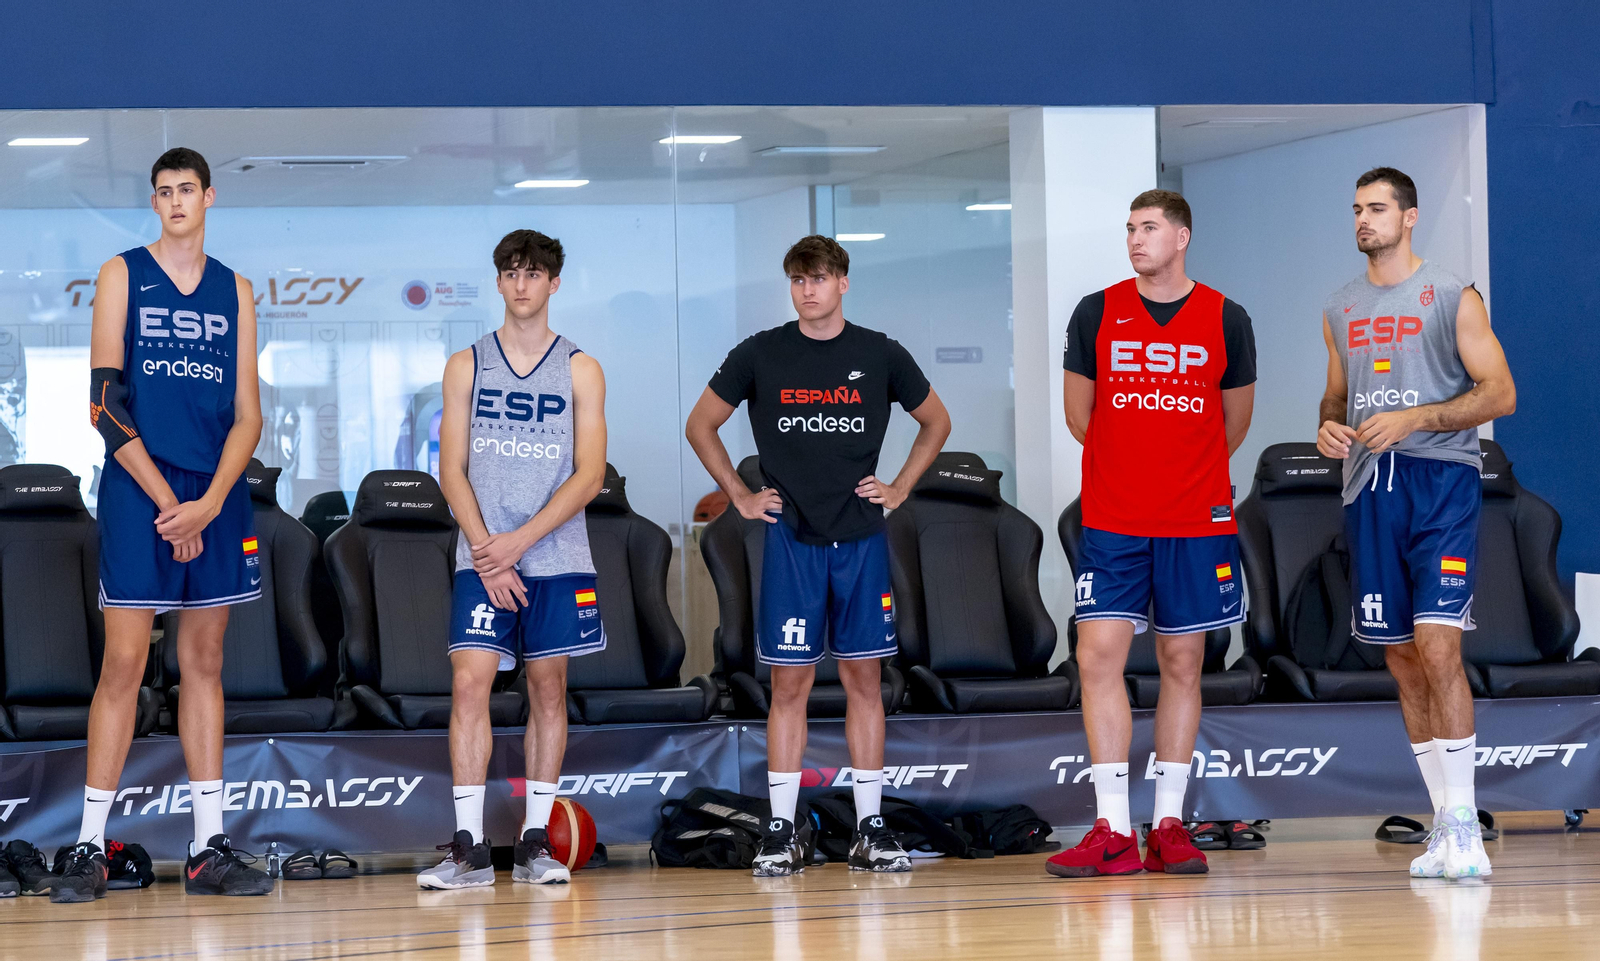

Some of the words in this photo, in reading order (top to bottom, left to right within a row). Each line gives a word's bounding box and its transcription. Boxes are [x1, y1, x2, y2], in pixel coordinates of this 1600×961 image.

[246, 277, 364, 305] ASSY
[139, 306, 229, 341] ESP
[1347, 315, 1423, 349] ESP
[138, 340, 229, 357] BASKETBALL
[1110, 340, 1209, 374] ESP
[142, 356, 223, 384] endesa
[1108, 376, 1207, 387] BASKETBALL
[475, 388, 566, 422] ESP
[780, 386, 862, 404] ESPAÑA
[1112, 389, 1204, 414] endesa
[1353, 384, 1419, 410] edea
[778, 412, 865, 433] endesa
[473, 436, 561, 459] endesa
[31, 485, 64, 493] EMBASSY
[245, 556, 260, 567] ES
[1219, 582, 1235, 594] ESP
[1440, 577, 1466, 587] ESP
[470, 603, 495, 630] fi
[578, 609, 598, 619] ESP
[1360, 593, 1383, 621] fi
[466, 628, 496, 638] network
[781, 617, 806, 645] fi
[1361, 620, 1389, 629] network
[777, 643, 811, 652] network
[556, 771, 689, 798] DRIFT
